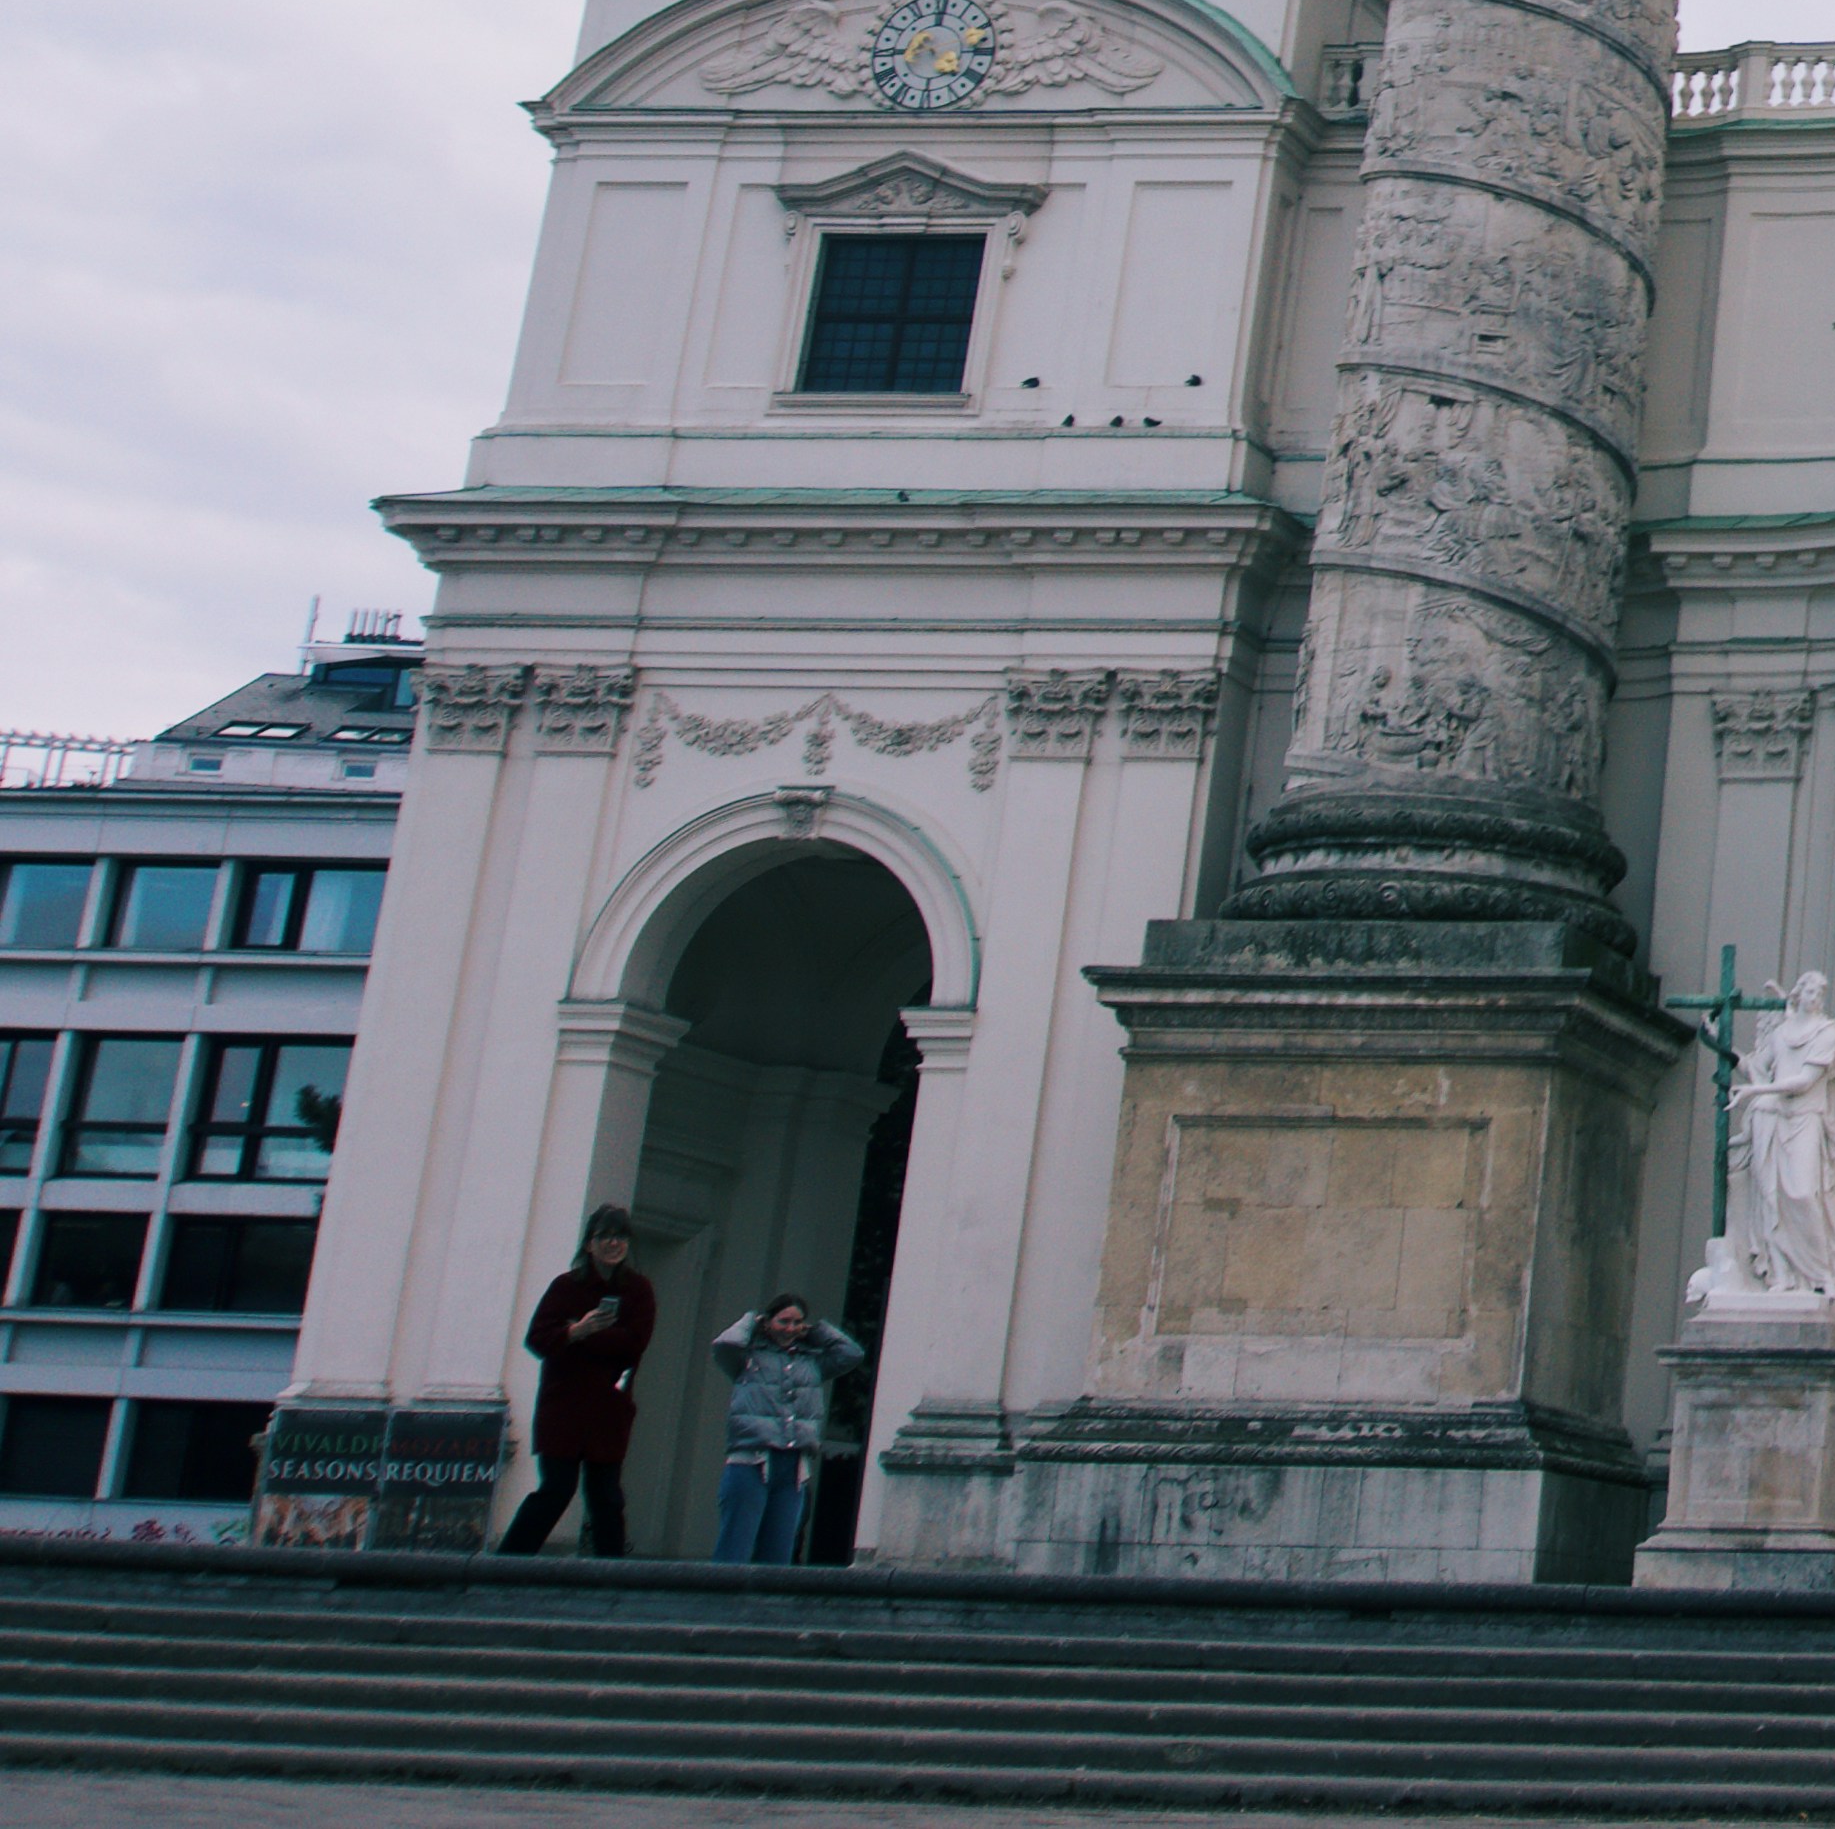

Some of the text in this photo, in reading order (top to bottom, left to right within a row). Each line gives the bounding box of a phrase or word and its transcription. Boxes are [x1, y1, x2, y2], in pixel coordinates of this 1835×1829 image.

[275, 1433, 380, 1454] VIVALDI
[268, 1458, 379, 1481] SEASONS
[384, 1461, 496, 1487] REQUIEM
